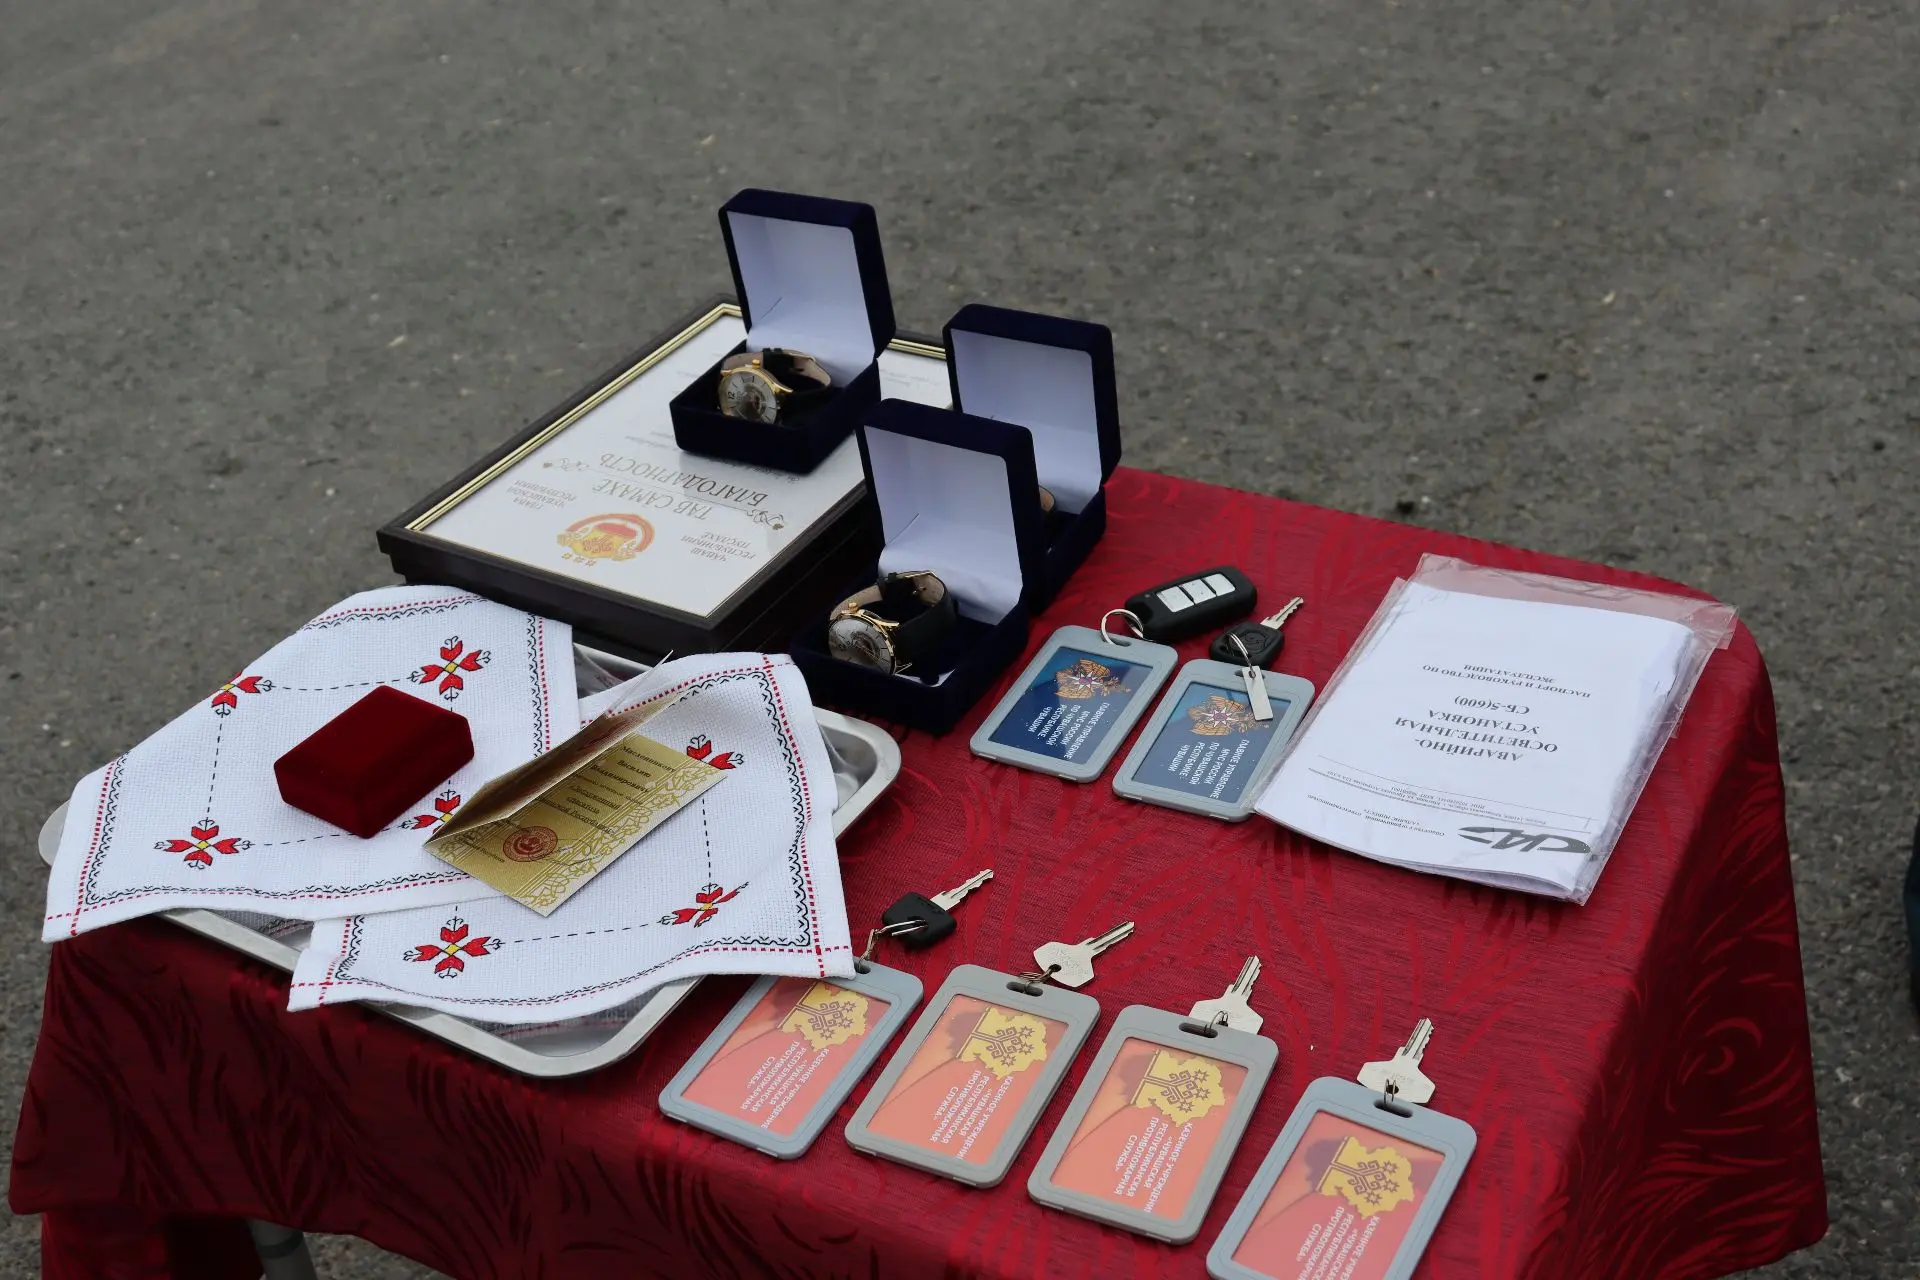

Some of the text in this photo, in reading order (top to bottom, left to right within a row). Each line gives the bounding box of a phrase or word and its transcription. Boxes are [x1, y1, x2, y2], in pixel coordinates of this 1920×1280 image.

[727, 390, 736, 400] 12
[599, 453, 769, 507] БЛАГОДАРНОСТЬ
[674, 501, 713, 520] ТАВ
[1422, 665, 1440, 673] ПО
[1441, 669, 1523, 687] РУКОВОДСТВО
[1463, 664, 1556, 684] ЭКСПЛУАТАЦИИ
[1454, 695, 1531, 715] СБ-5(600)
[1535, 684, 1591, 699] ПАСПОРТ
[1028, 706, 1053, 733] ЧУВАШИИ
[1046, 704, 1081, 747] ПО ЧУВАШСКОЙ
[1060, 710, 1091, 747] МЧС РОССИИ
[1063, 702, 1111, 760] ГЛАВНОЕ УПРАВЛЕНИЕ
[1394, 717, 1558, 753] ОСВЕТИТЕЛЬНАЯ
[1428, 710, 1541, 735] УСТАНОВКА
[1167, 744, 1190, 772] ЧУВАШИИ
[1188, 742, 1221, 785] ПО ЧУВАШСКОЙ
[1203, 748, 1230, 785] МЧС РОССИИ
[1209, 739, 1250, 799] ГЛАВНОЕ УПРАВЛЕНИЕ
[1414, 739, 1524, 762] АВАРИЙНО-
[740, 1040, 800, 1110] ПРОТИВОПОЖАРНАЯ
[750, 1048, 807, 1112] РЕСПУБЛИКАНСКАЯ
[761, 1048, 830, 1130] КАЗЕННОЕ УЧРЕЖДЕНИЕ
[930, 1070, 982, 1142] ПРОТИВОПОЖАРНАЯ
[941, 1075, 990, 1144] РЕСПУБЛИКАНСКАЯ
[986, 1076, 1014, 1113] КАЗЕННОЕ
[1114, 1117, 1159, 1196] ПРОТИВОПОЖАРНАЯ
[1127, 1122, 1169, 1198] РЕСПУБЛИКАНСКАЯ
[1169, 1122, 1193, 1162] КАЗЕННОЕ
[1354, 1216, 1380, 1258] КАЗЕННОЕ
